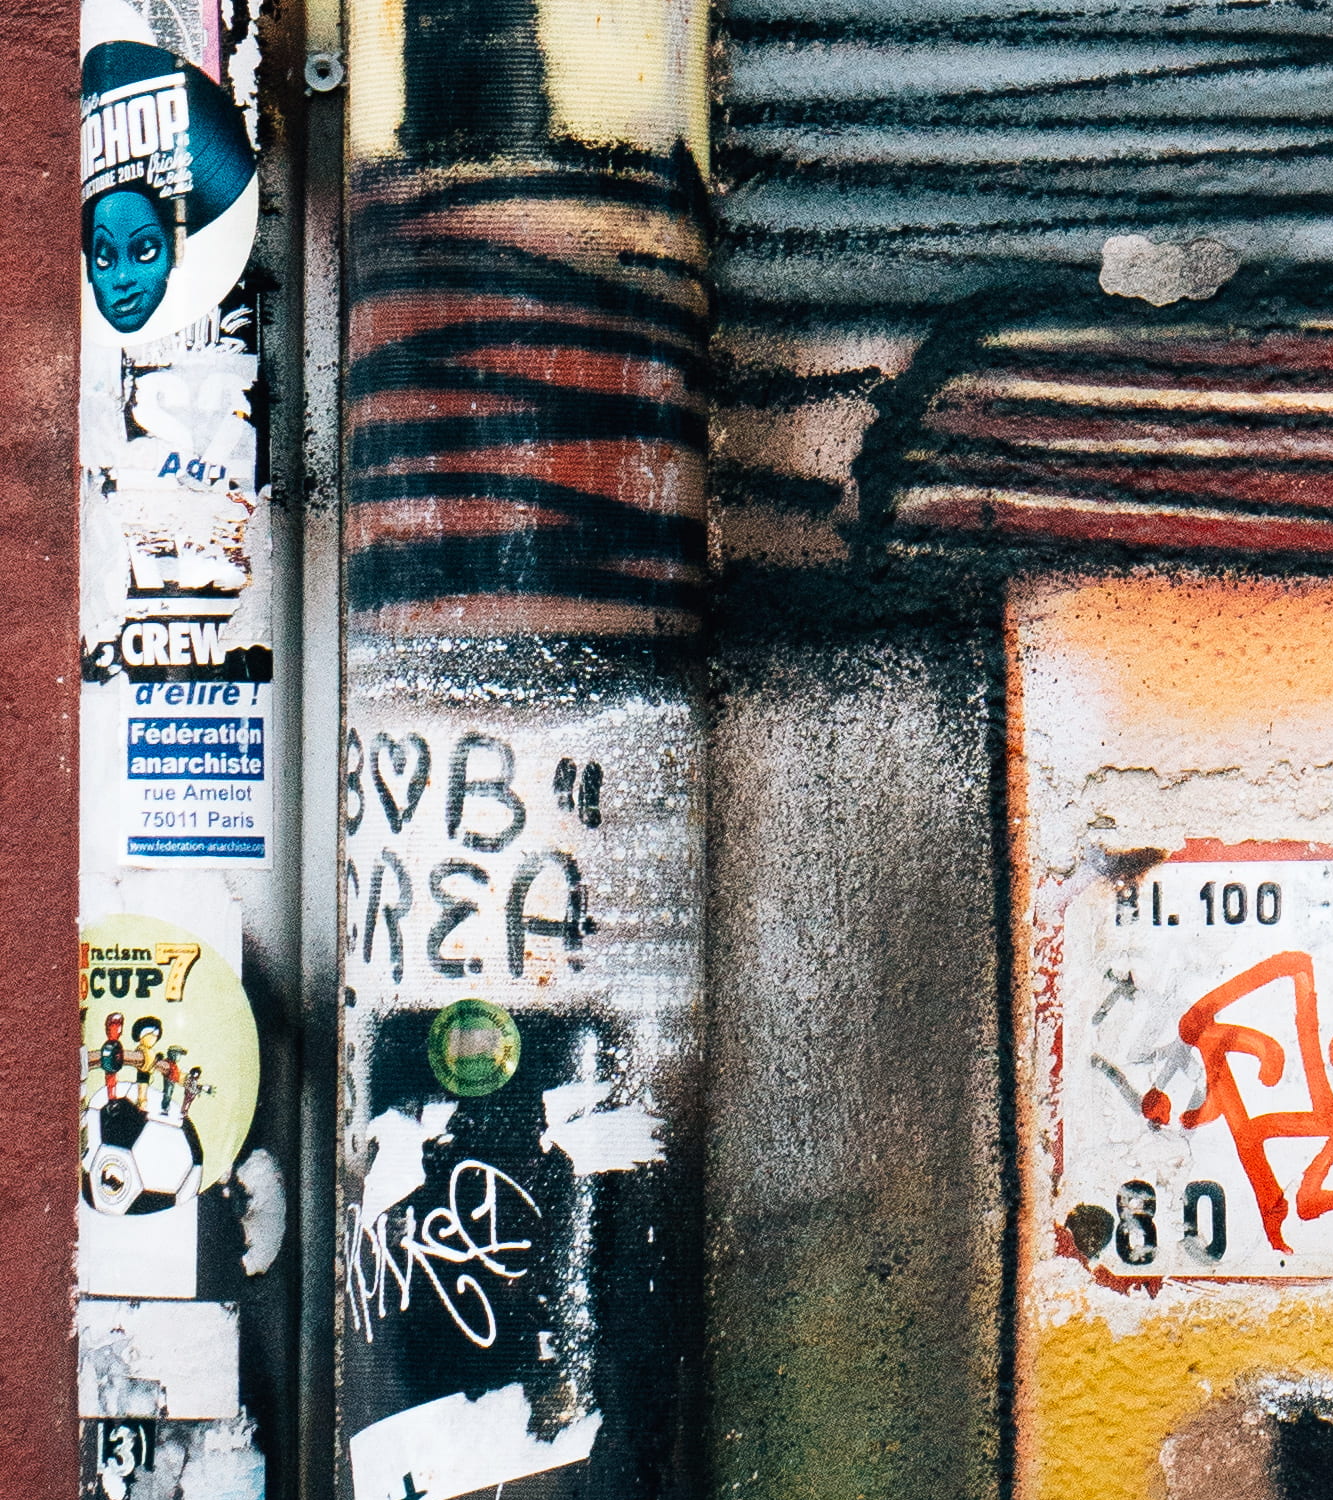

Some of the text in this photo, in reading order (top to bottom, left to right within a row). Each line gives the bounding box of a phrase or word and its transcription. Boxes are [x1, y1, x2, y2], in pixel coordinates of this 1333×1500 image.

[117, 162, 145, 184] 2016
[130, 721, 262, 746] Fédération
[130, 751, 263, 775] anarchiste
[144, 783, 253, 801] rue Amelot
[141, 810, 255, 829] 75011 Paris
[1199, 880, 1283, 926] 100
[89, 966, 165, 999] CUP
[154, 942, 202, 1003] 7
